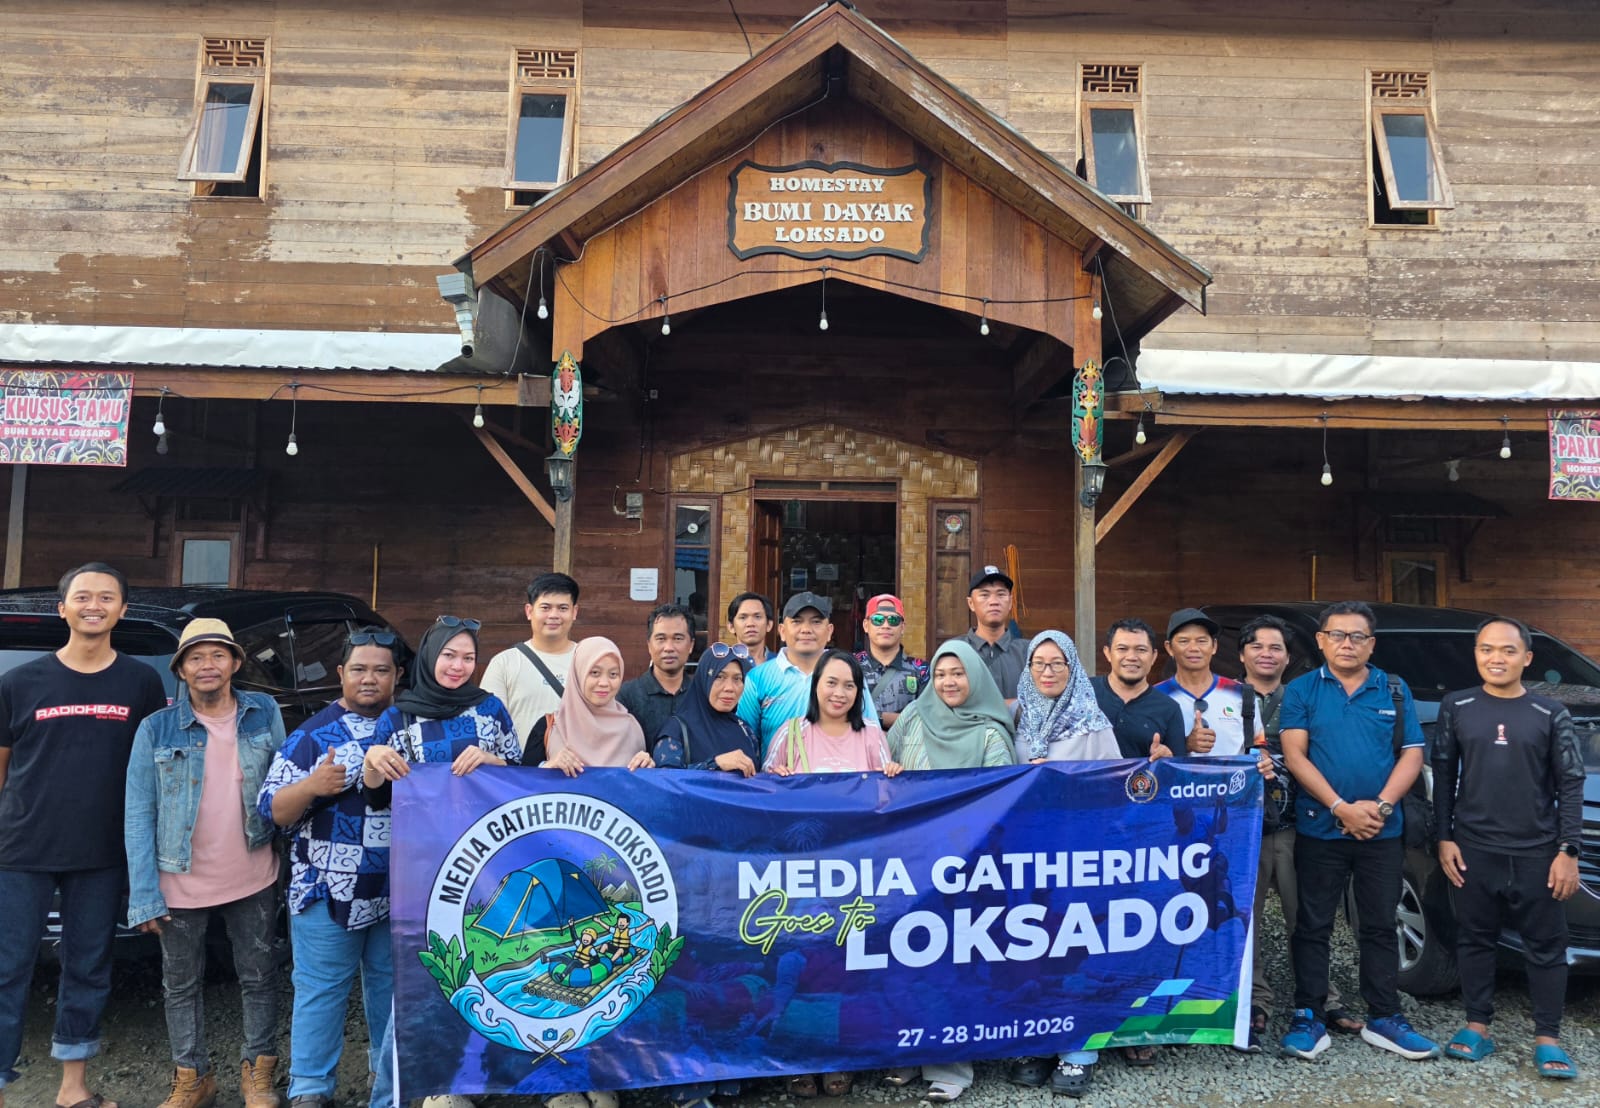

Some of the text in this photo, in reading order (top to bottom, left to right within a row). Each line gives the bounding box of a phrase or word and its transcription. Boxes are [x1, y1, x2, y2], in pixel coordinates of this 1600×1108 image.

[769, 177, 885, 192] HOMESTAY
[743, 202, 914, 223] BUMI DAYAK
[775, 227, 885, 243] LOKSADO
[5, 396, 122, 422] KHUSUS TAMU
[4, 427, 111, 437] BUMI DAYAK LOKSADO
[35, 705, 129, 720] RADIOHEAD
[1170, 782, 1228, 799] adaro
[439, 802, 669, 905] MEDIA GATHERING LOKSADO
[738, 842, 1212, 899] MEDIA GATHERING
[739, 888, 876, 955] Goes to
[845, 892, 1209, 971] LOKSADO
[897, 1028, 925, 1047] 27
[942, 1026, 969, 1044] 28
[973, 1020, 1019, 1042] Juni
[1023, 1015, 1075, 1037] 2026
